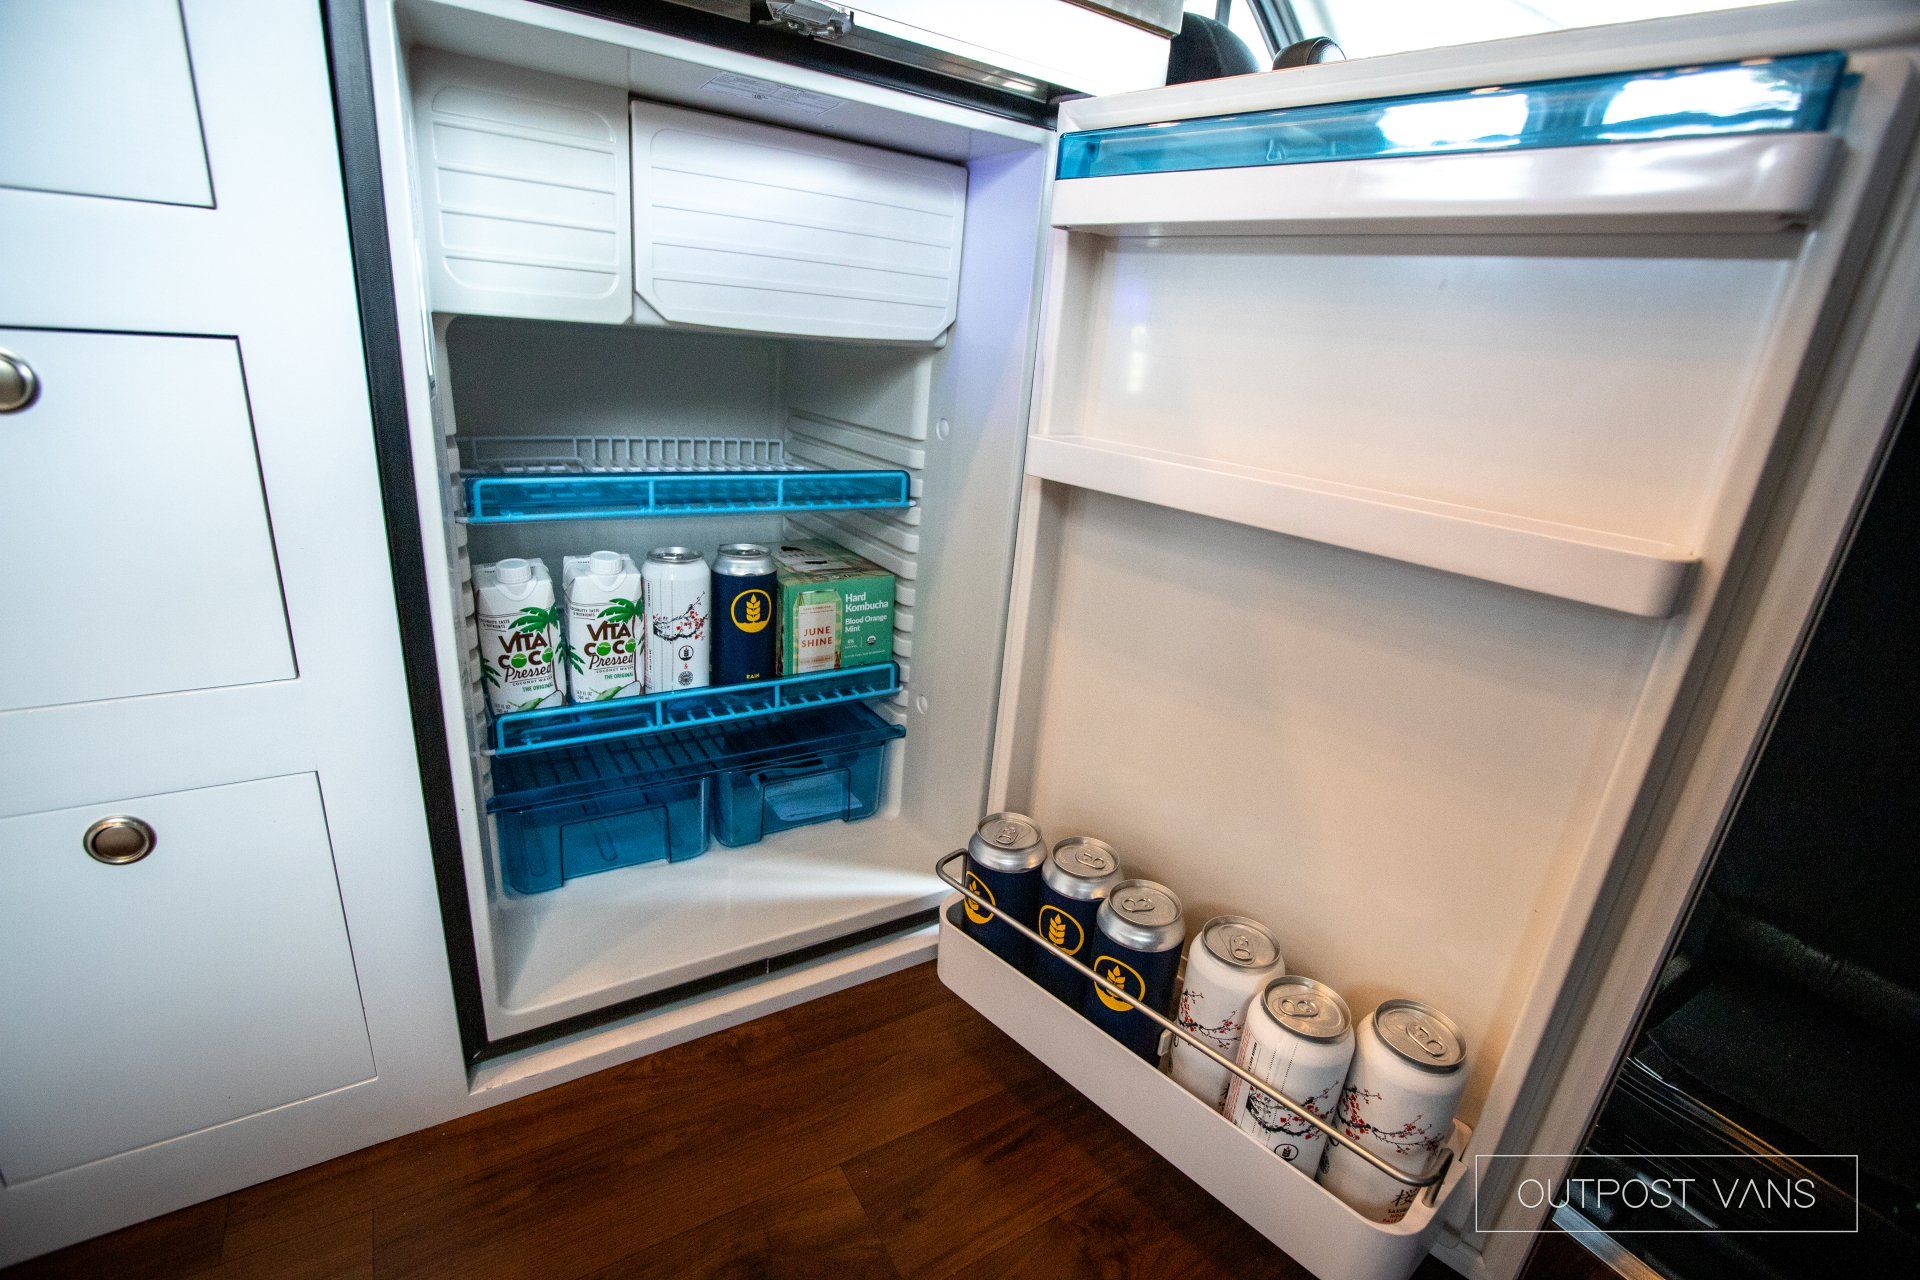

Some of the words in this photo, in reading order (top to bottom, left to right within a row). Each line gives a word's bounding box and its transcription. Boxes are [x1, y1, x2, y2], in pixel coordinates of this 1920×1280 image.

[845, 592, 867, 603] Hard
[845, 600, 889, 613] Kombucha
[845, 616, 864, 625] Blood
[865, 614, 888, 623] Orange
[586, 620, 632, 642] VITA
[804, 626, 831, 637] JUNE
[498, 631, 548, 654] VITA
[584, 637, 637, 657] COCO
[801, 637, 833, 648] SHINE
[498, 648, 554, 669] COCO
[589, 654, 634, 670] Pressed
[504, 663, 552, 683] Pressed
